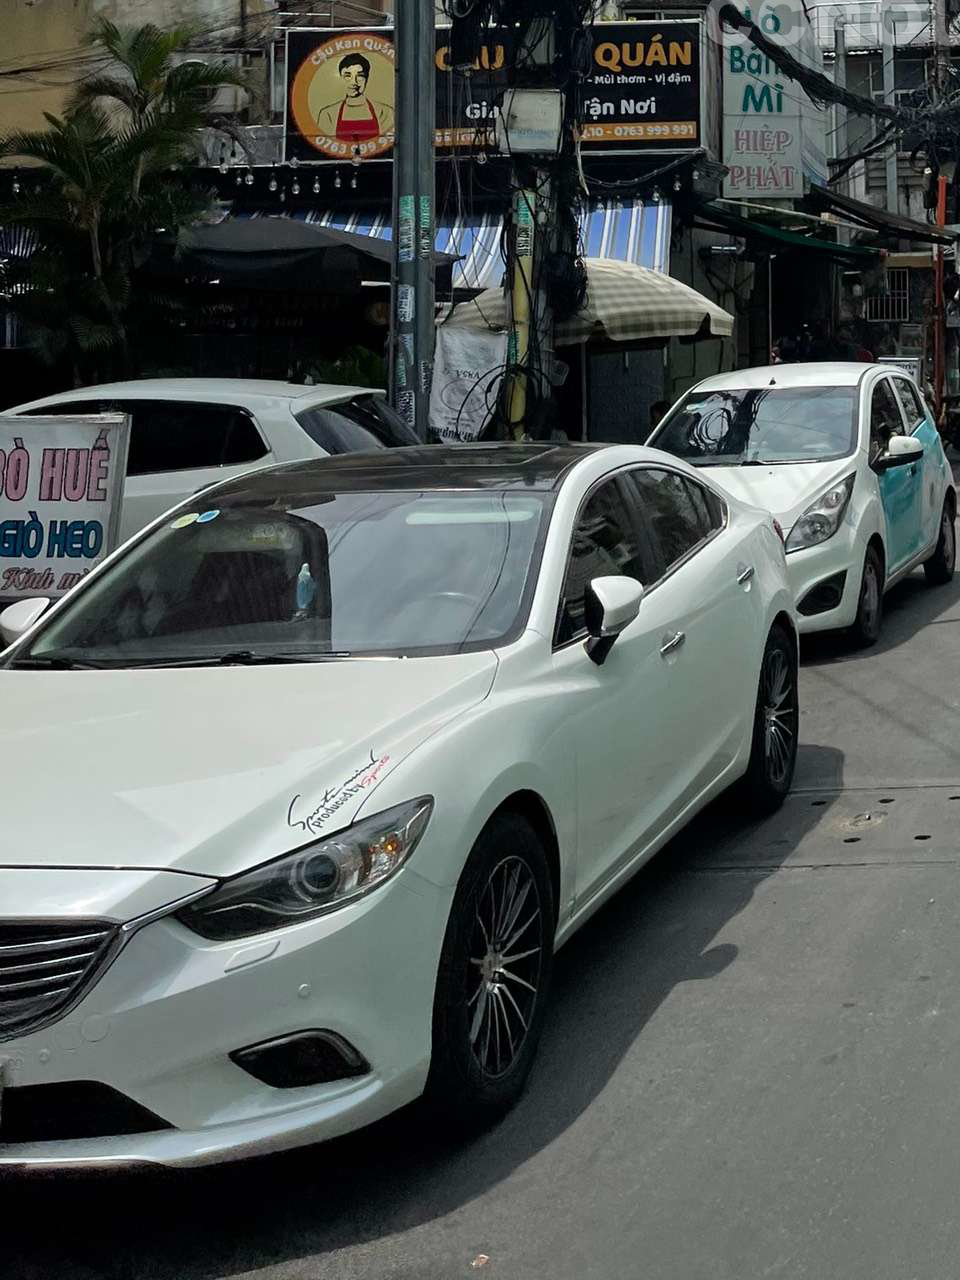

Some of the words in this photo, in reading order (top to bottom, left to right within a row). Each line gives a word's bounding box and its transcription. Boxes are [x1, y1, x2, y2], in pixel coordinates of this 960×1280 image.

[594, 34, 692, 72] QUÁN
[595, 73, 615, 85] Mùi
[617, 74, 646, 85] thơm
[655, 73, 667, 86] Vị
[667, 72, 692, 86] đậm
[621, 97, 656, 115] Nơi
[742, 83, 784, 113] Mì
[614, 125, 644, 137] 0763
[647, 124, 669, 136] 999
[0, 437, 30, 501] Ò
[39, 429, 111, 501] HUẾ
[47, 520, 103, 558] HEO
[311, 792, 353, 828] produced
